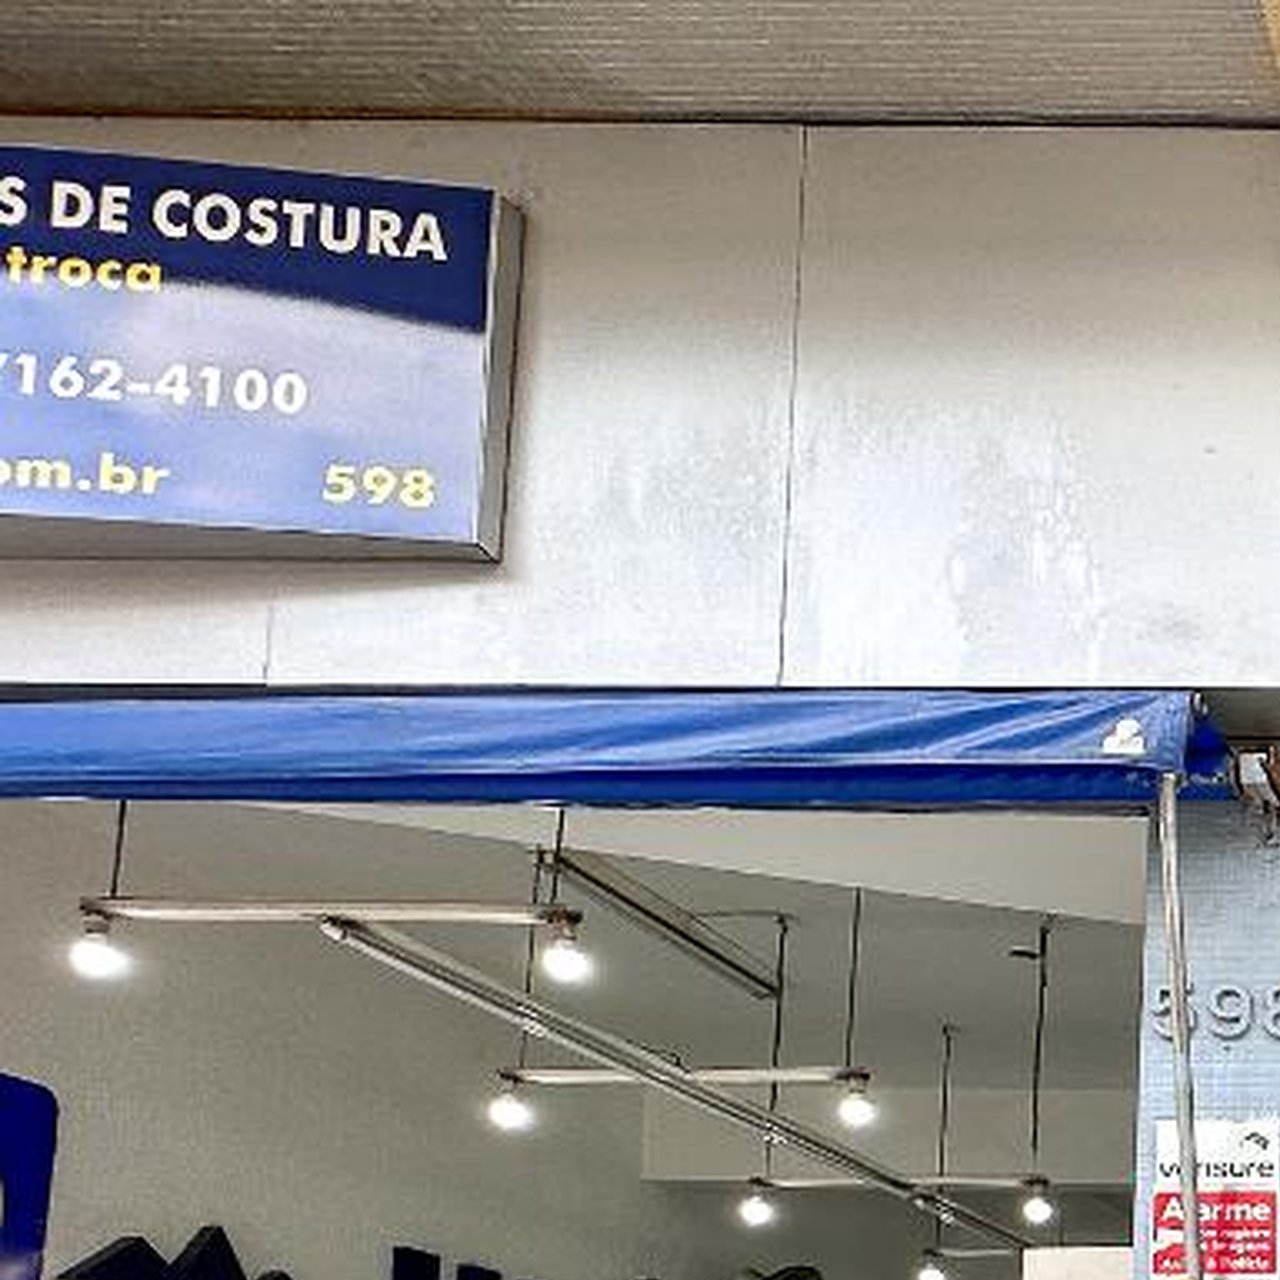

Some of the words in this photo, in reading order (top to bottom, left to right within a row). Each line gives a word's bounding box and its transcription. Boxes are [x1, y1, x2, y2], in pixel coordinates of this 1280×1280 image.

[50, 182, 131, 234] DE
[152, 189, 449, 260] COSTURA
[7, 246, 162, 292] troca
[323, 464, 436, 508] 598
[1159, 1162, 1275, 1178] vrisure
[1163, 1196, 1271, 1221] Aarme
